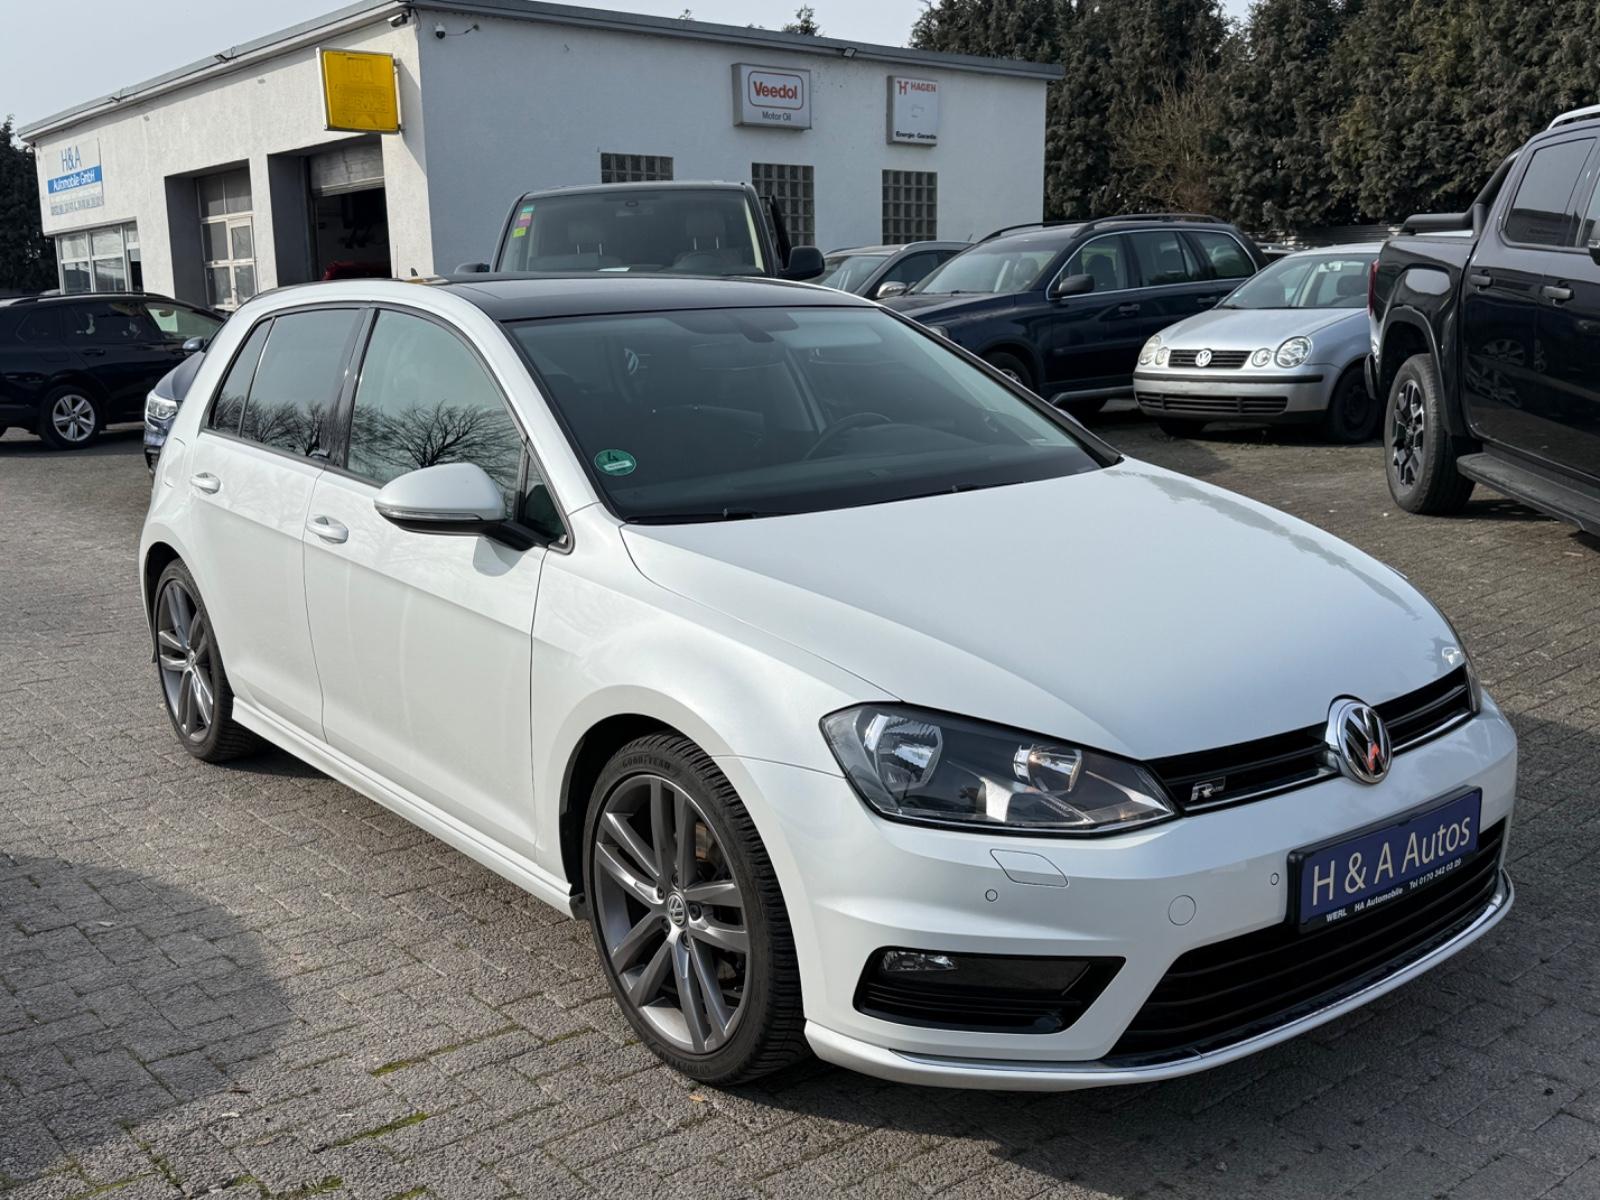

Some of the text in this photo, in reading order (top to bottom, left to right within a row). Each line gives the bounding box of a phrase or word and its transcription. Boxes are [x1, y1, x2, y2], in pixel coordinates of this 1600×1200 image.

[753, 81, 798, 99] Veedol
[911, 81, 936, 92] HAGEN
[762, 111, 792, 121] Motor Oil
[1312, 817, 1470, 906] H & A Autos
[1326, 908, 1347, 922] WERL
[1354, 901, 1365, 912] HA
[1366, 887, 1403, 908] Automobile
